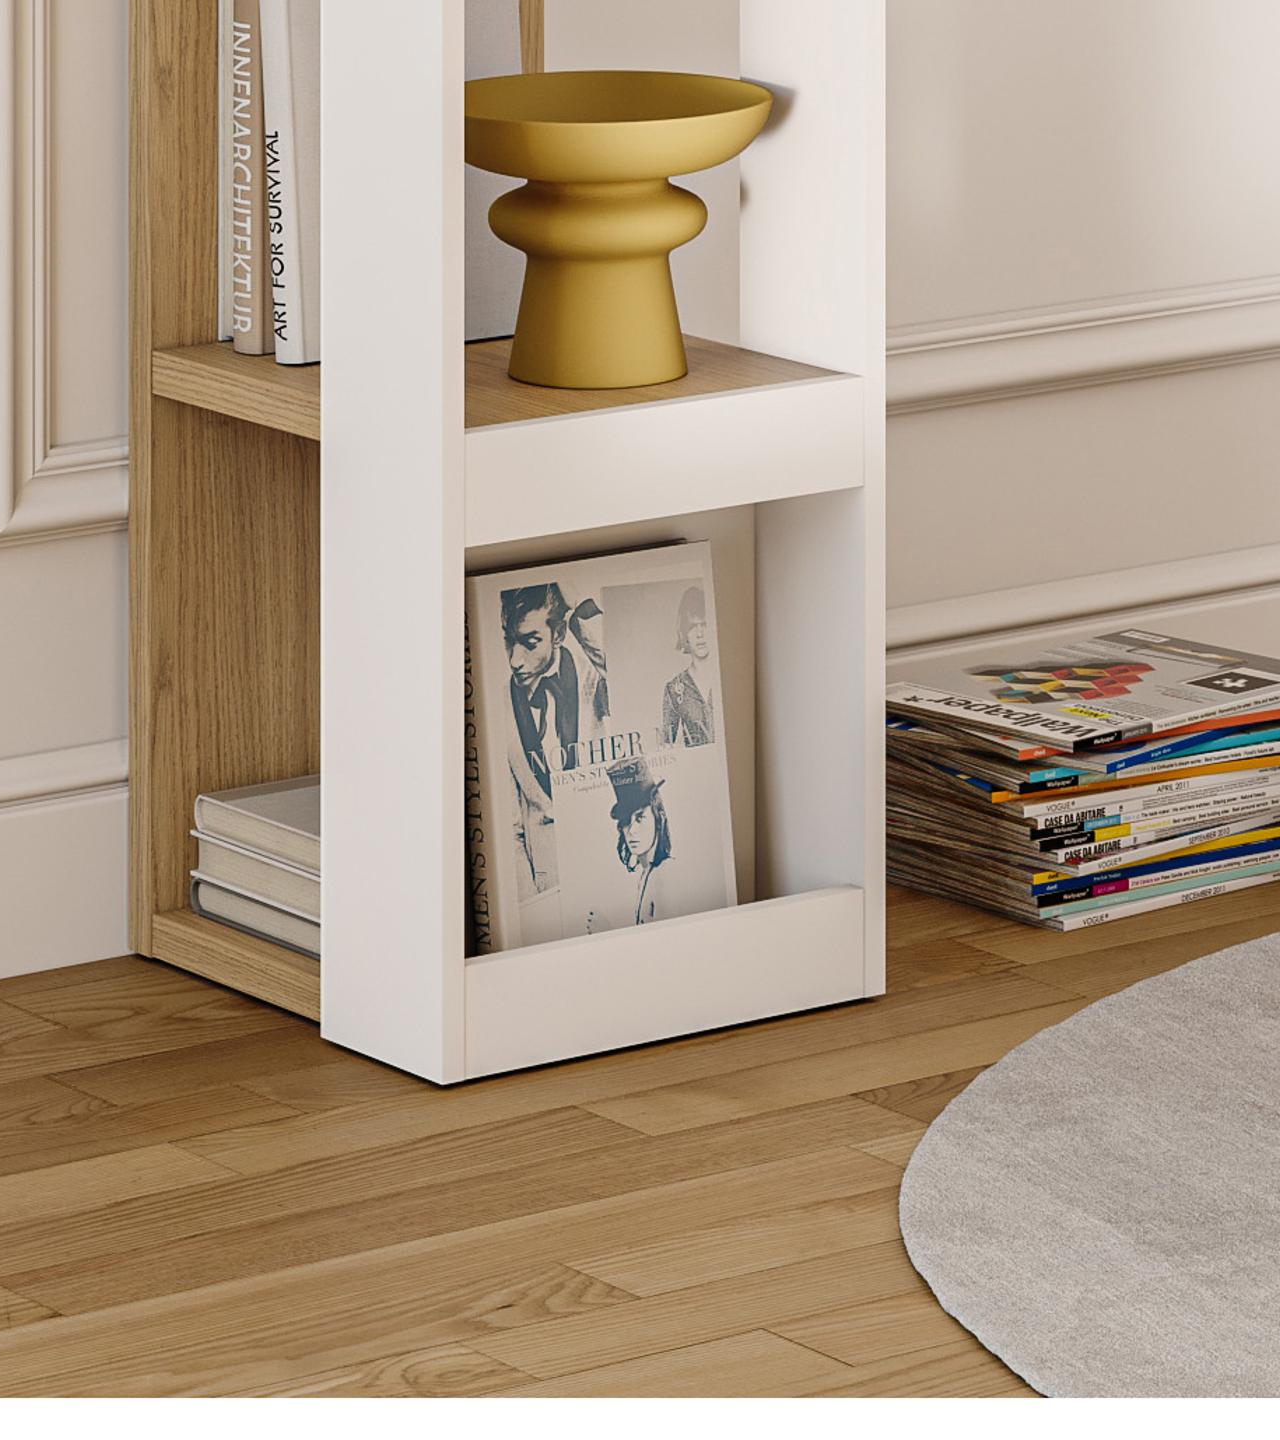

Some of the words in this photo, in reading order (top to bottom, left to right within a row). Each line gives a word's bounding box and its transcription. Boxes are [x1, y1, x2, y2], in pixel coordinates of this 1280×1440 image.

[232, 21, 252, 333] INNENARCHITEKTUR
[265, 130, 284, 235] SURVIVAL
[271, 243, 285, 289] FOR
[272, 298, 288, 341] ART
[465, 611, 477, 738] STOR
[465, 747, 484, 844] STYLE
[1044, 814, 1063, 828] CASE
[1064, 813, 1074, 826] DA
[1075, 807, 1106, 823] ABITARE
[1046, 801, 1070, 812] VOGUE
[1064, 848, 1081, 861] CASE
[1083, 847, 1092, 858] DA
[1093, 840, 1121, 855] ABITARE
[471, 852, 492, 947] MEN'S
[1083, 914, 1104, 926] VOGUE
